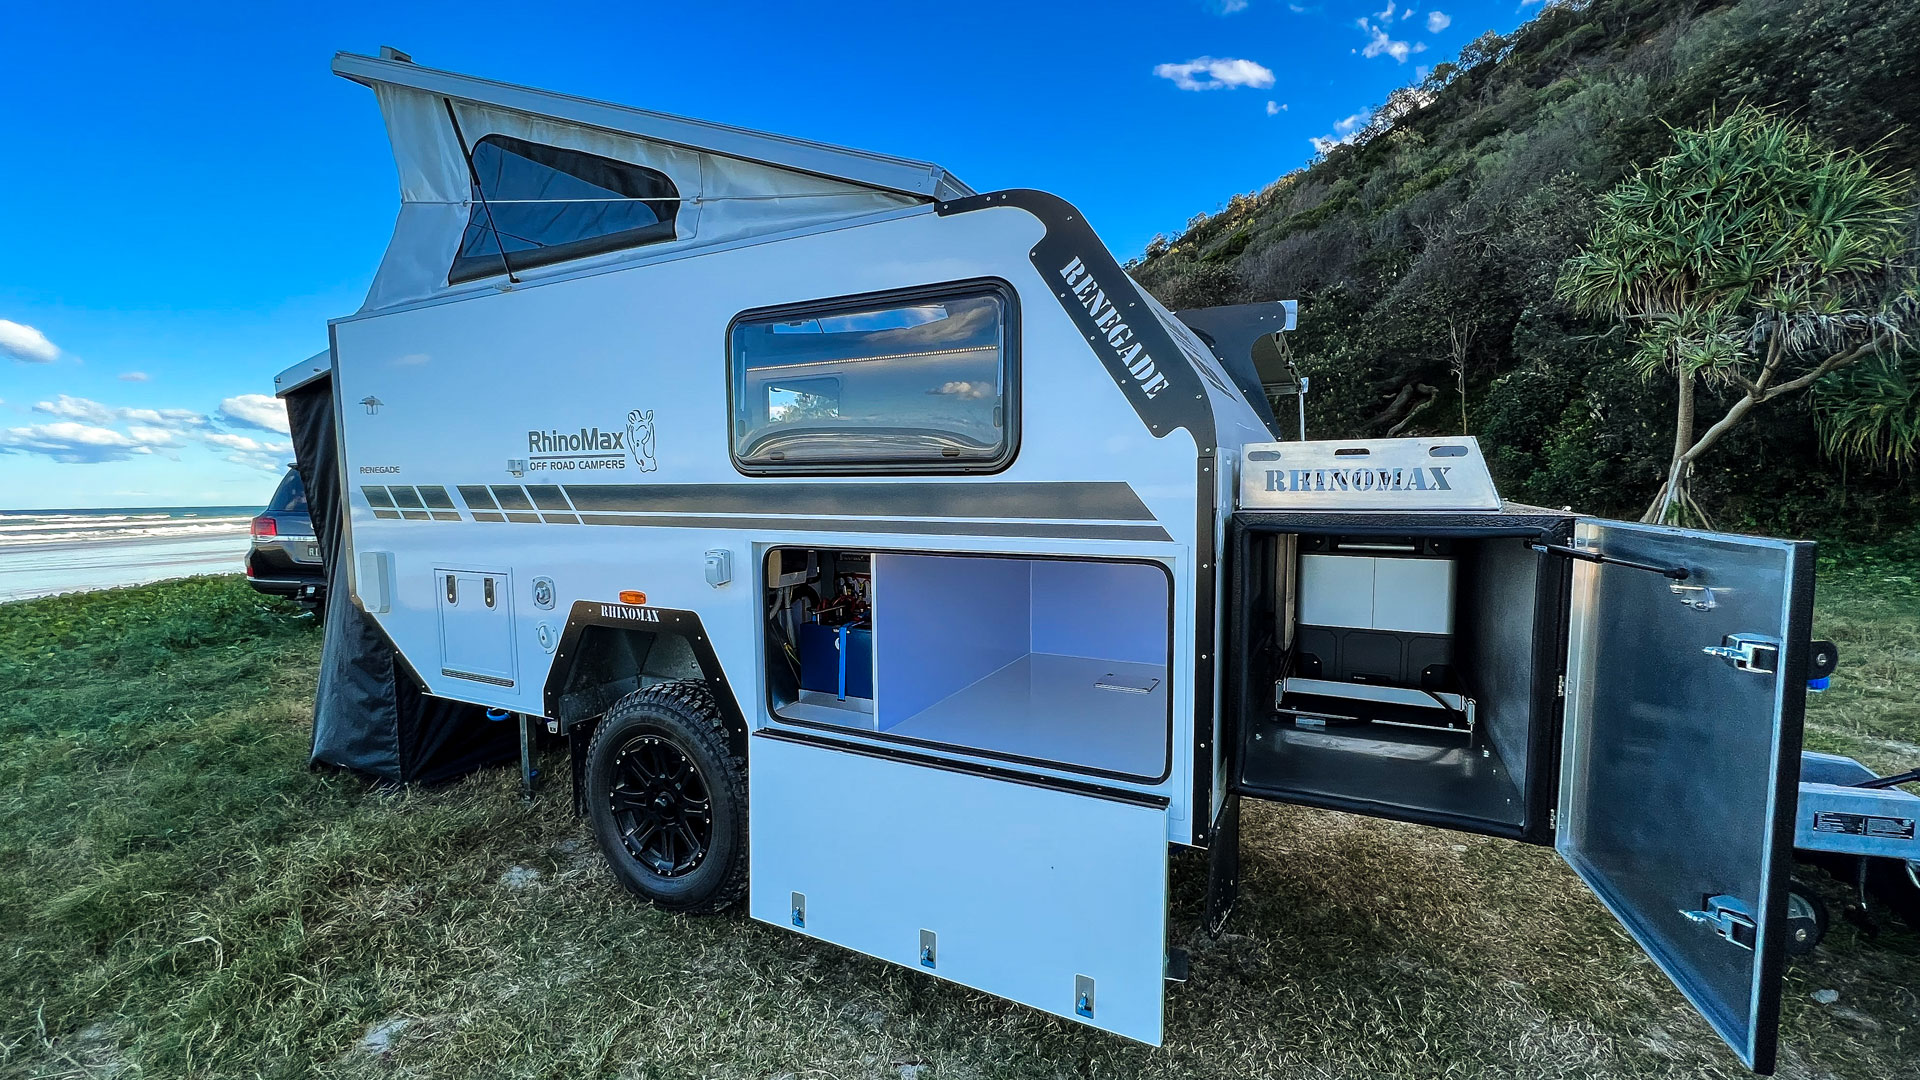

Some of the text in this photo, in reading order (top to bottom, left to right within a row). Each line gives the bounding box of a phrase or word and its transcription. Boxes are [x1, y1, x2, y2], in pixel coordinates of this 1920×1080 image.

[1059, 255, 1170, 400] RENEGADE
[528, 427, 625, 452] RhinoMax
[359, 466, 401, 475] RENEGADE
[529, 459, 626, 471] OFF ROAD CAMPERS
[1264, 466, 1453, 492] RHINOMAX
[600, 604, 660, 623] RHINOMAX
